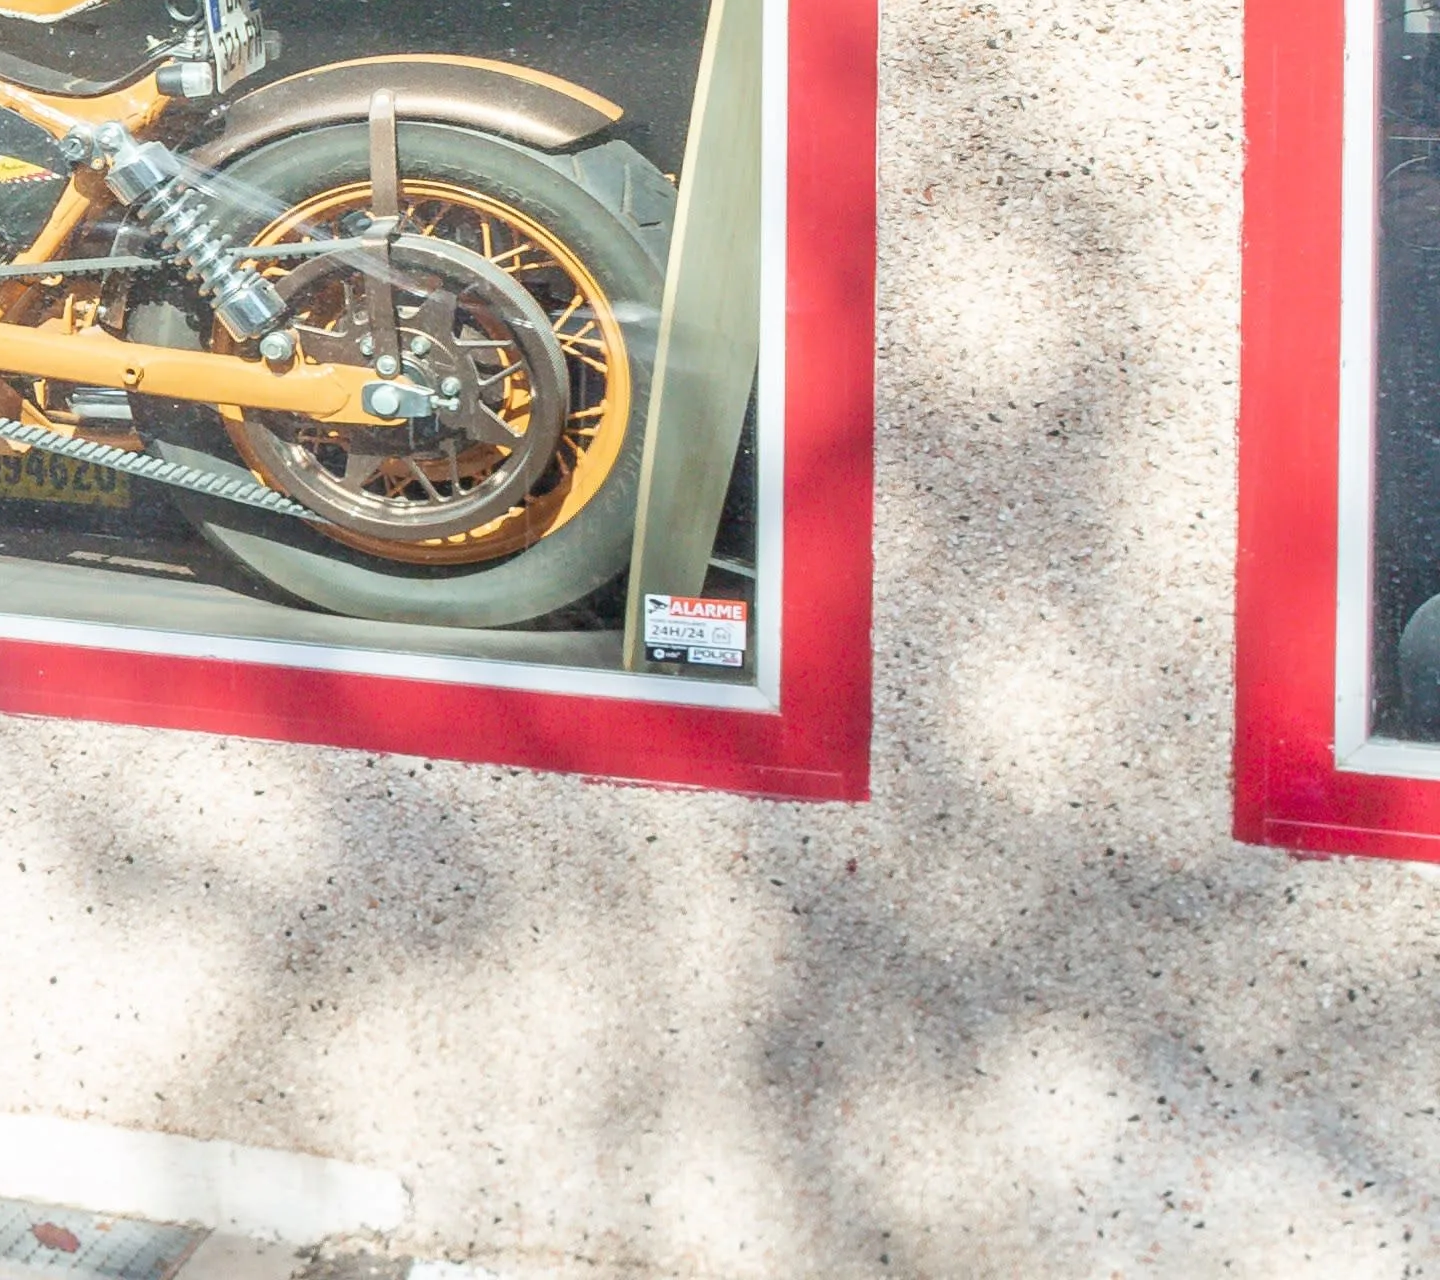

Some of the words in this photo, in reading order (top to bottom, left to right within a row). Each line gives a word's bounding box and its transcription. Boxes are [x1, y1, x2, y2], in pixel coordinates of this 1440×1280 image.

[671, 601, 743, 620] ALARME
[652, 625, 705, 638] 24H/24
[694, 649, 739, 659] POLICE
